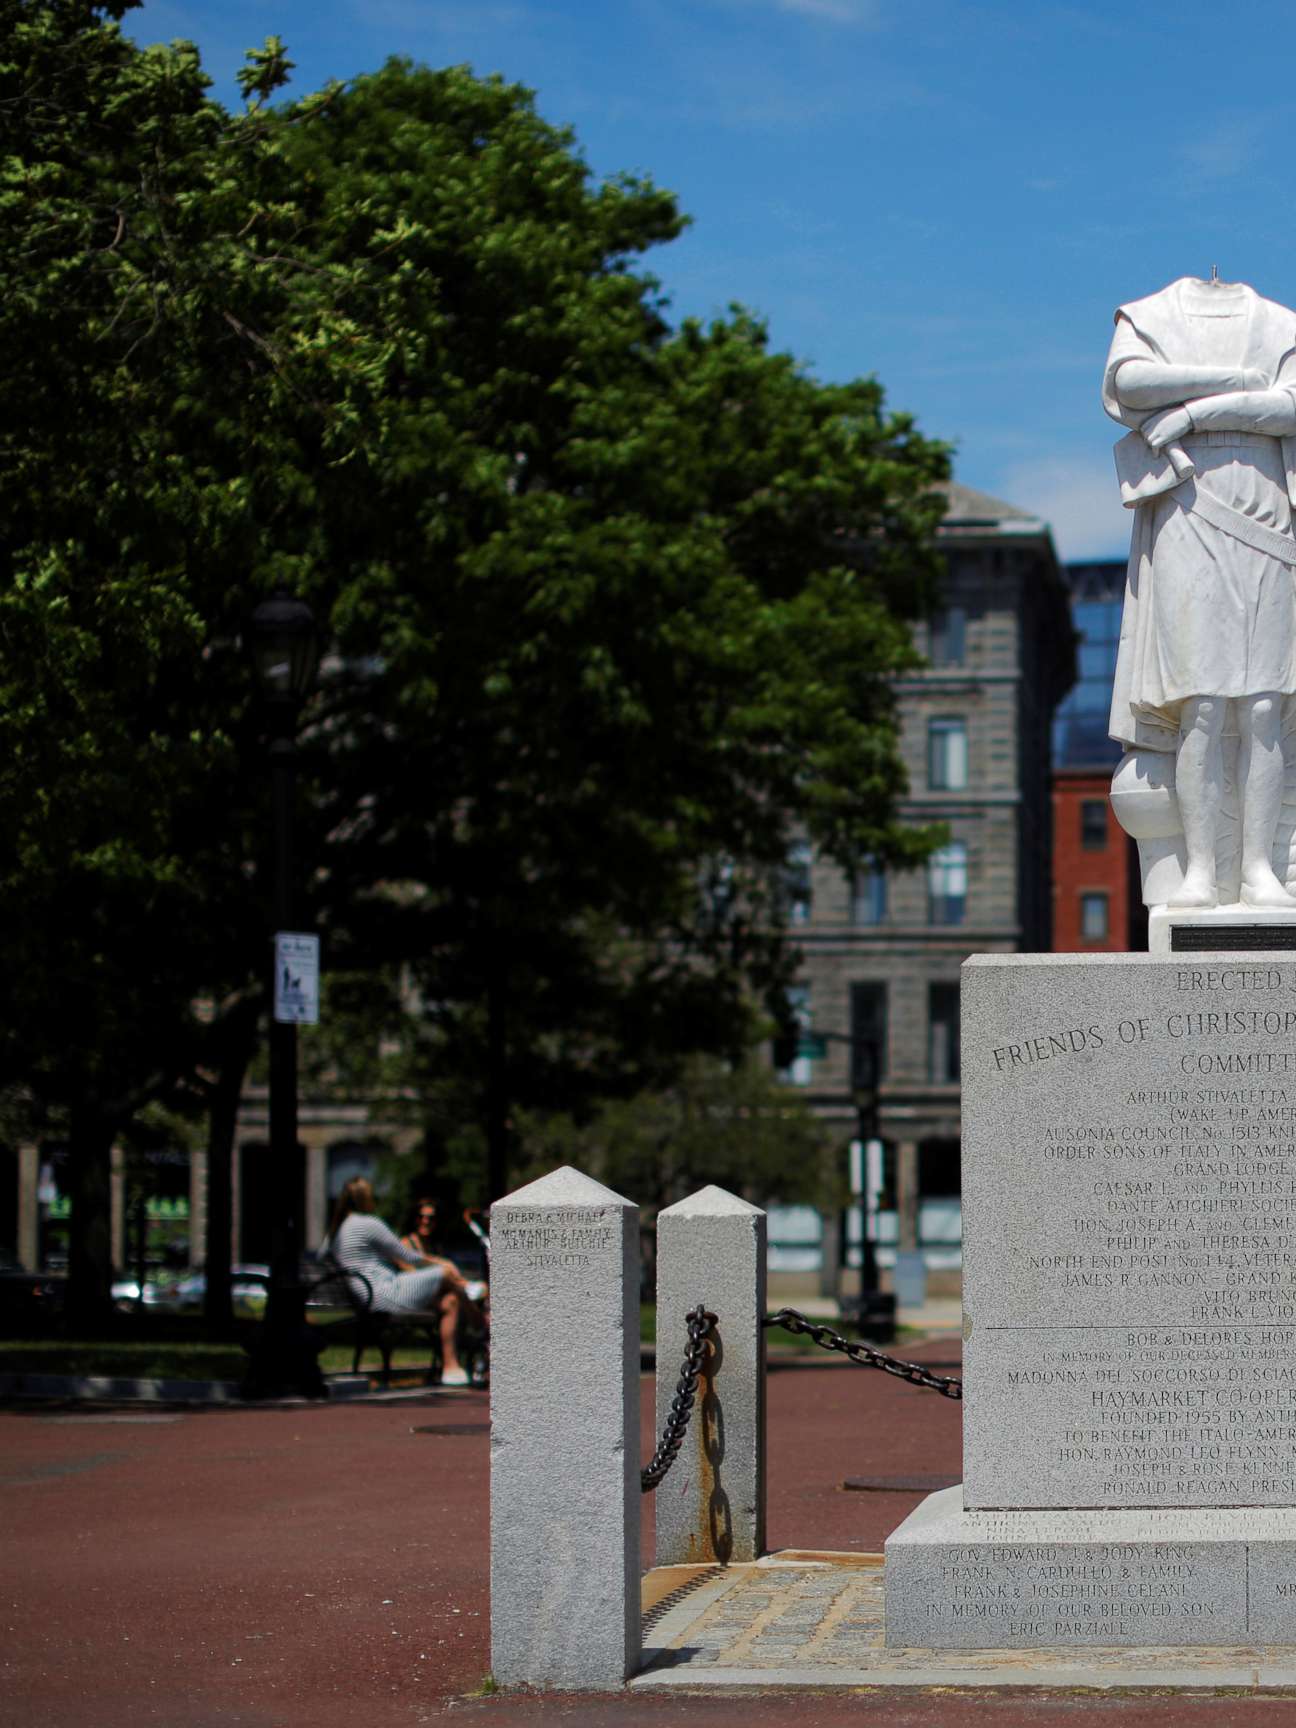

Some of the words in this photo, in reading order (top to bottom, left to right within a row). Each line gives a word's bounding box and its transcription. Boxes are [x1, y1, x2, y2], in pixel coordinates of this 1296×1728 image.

[1179, 970, 1280, 991] ERECTED
[993, 1025, 1104, 1070] FRIENDS
[1119, 1019, 1150, 1043] OF
[1127, 1091, 1189, 1104] ARTHUR
[1170, 1107, 1217, 1123] (WAKE
[1229, 1108, 1249, 1121] UP
[1044, 1127, 1115, 1141] AUSONIA
[1231, 1126, 1260, 1140] 1513
[1044, 1146, 1096, 1159] ORDER
[1103, 1145, 1146, 1159] SONS
[1153, 1145, 1171, 1159] OF
[1180, 1145, 1222, 1159] ITALY
[1231, 1145, 1245, 1158] IN
[1173, 1163, 1229, 1176] GRAND
[1235, 1163, 1287, 1176] LODGE
[1093, 1182, 1152, 1196] CAESAR
[1219, 1181, 1283, 1195] PHYLLIS
[1107, 1200, 1157, 1214] DANTE
[1117, 1218, 1177, 1232] JOSEPH
[1199, 1236, 1270, 1249] THERESA
[1030, 1255, 1083, 1269] NORTH
[1091, 1255, 1123, 1268] END
[1130, 1255, 1169, 1268] POST
[1061, 1274, 1113, 1287] JAMES
[1225, 1272, 1281, 1286] GRAND
[1203, 1291, 1240, 1304] VITO
[1192, 1306, 1243, 1320] FRANK
[1128, 1332, 1157, 1346] BOB
[1164, 1335, 1173, 1345] &
[1182, 1332, 1251, 1345] DELORES
[1008, 1370, 1088, 1385] MADONNA
[1095, 1370, 1124, 1383] DEL
[1132, 1368, 1220, 1383] SOCCORSO
[1092, 1391, 1210, 1407] HAYMARKET
[1102, 1411, 1178, 1425] FOUNDED
[1186, 1410, 1221, 1424] 1955
[1229, 1410, 1247, 1423] BY
[1063, 1430, 1084, 1443] TO
[1091, 1429, 1151, 1443] BENEFIT
[1163, 1429, 1192, 1442] THE
[1104, 1447, 1182, 1460] RAYMOND
[1191, 1447, 1220, 1459] LEO
[1114, 1462, 1172, 1476] JOSEPH
[1179, 1465, 1186, 1475] &
[1192, 1462, 1233, 1475] ROSE
[1103, 1481, 1167, 1494] RONALD
[1176, 1480, 1240, 1493] REAGAN
[993, 1547, 1057, 1562] EDWARD
[1101, 1546, 1143, 1561] JODY
[1154, 1546, 1194, 1561] KING
[943, 1567, 994, 1581] FRANK
[1122, 1568, 1131, 1578] &
[1139, 1565, 1195, 1578] FAMILY
[954, 1586, 1007, 1599] FRANK
[1031, 1584, 1120, 1598] JOSEPHINE
[926, 1604, 942, 1617] IN
[952, 1603, 1020, 1617] MEMORY
[1028, 1603, 1046, 1617] OF
[1058, 1603, 1092, 1617] OUR
[1101, 1602, 1171, 1617] BELOVED
[1180, 1602, 1215, 1616] SON
[1010, 1622, 1045, 1636] ERIC
